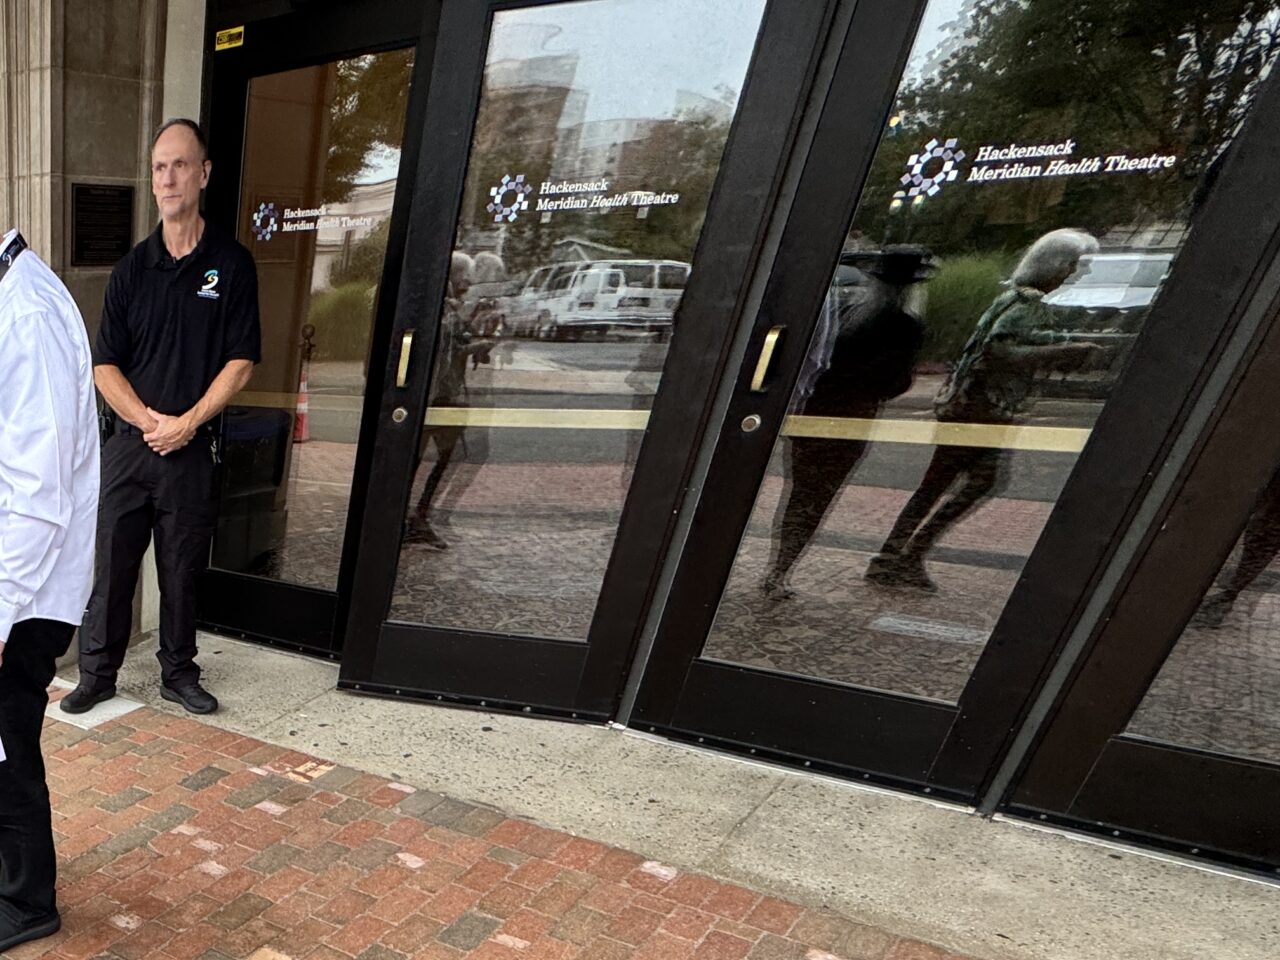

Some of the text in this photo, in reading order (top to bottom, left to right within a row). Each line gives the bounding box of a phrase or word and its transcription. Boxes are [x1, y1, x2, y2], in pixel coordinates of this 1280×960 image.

[974, 138, 1077, 162] Hackensack
[967, 153, 1177, 182] Meridian Health Theatre
[539, 178, 608, 195] Hackensack
[536, 191, 680, 211] Meridian Health Theatre
[284, 204, 327, 219] Hackensack
[282, 221, 315, 232] Meridian
